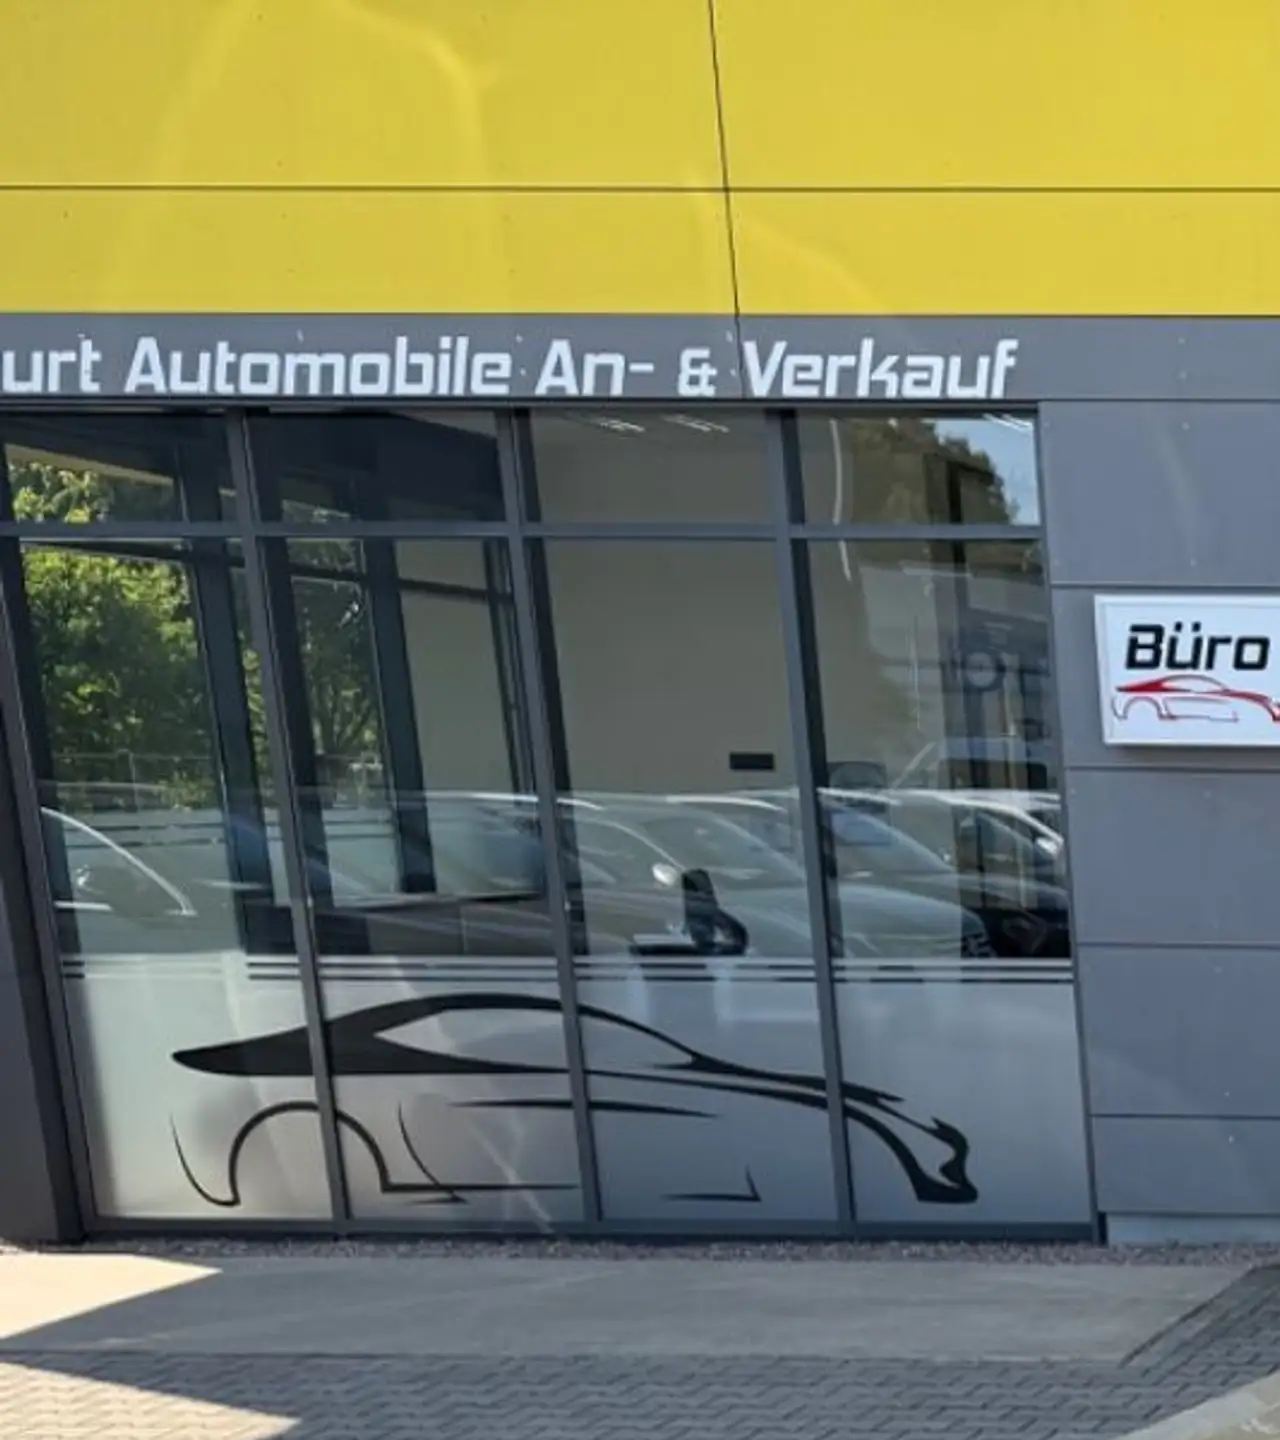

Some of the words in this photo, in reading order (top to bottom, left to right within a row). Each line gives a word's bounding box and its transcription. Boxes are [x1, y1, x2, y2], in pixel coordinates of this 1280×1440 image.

[124, 336, 513, 396] Automobile
[535, 338, 655, 397] An-
[677, 346, 718, 398] &
[742, 337, 1019, 398] Verkauf
[1125, 621, 1270, 671] Büro
